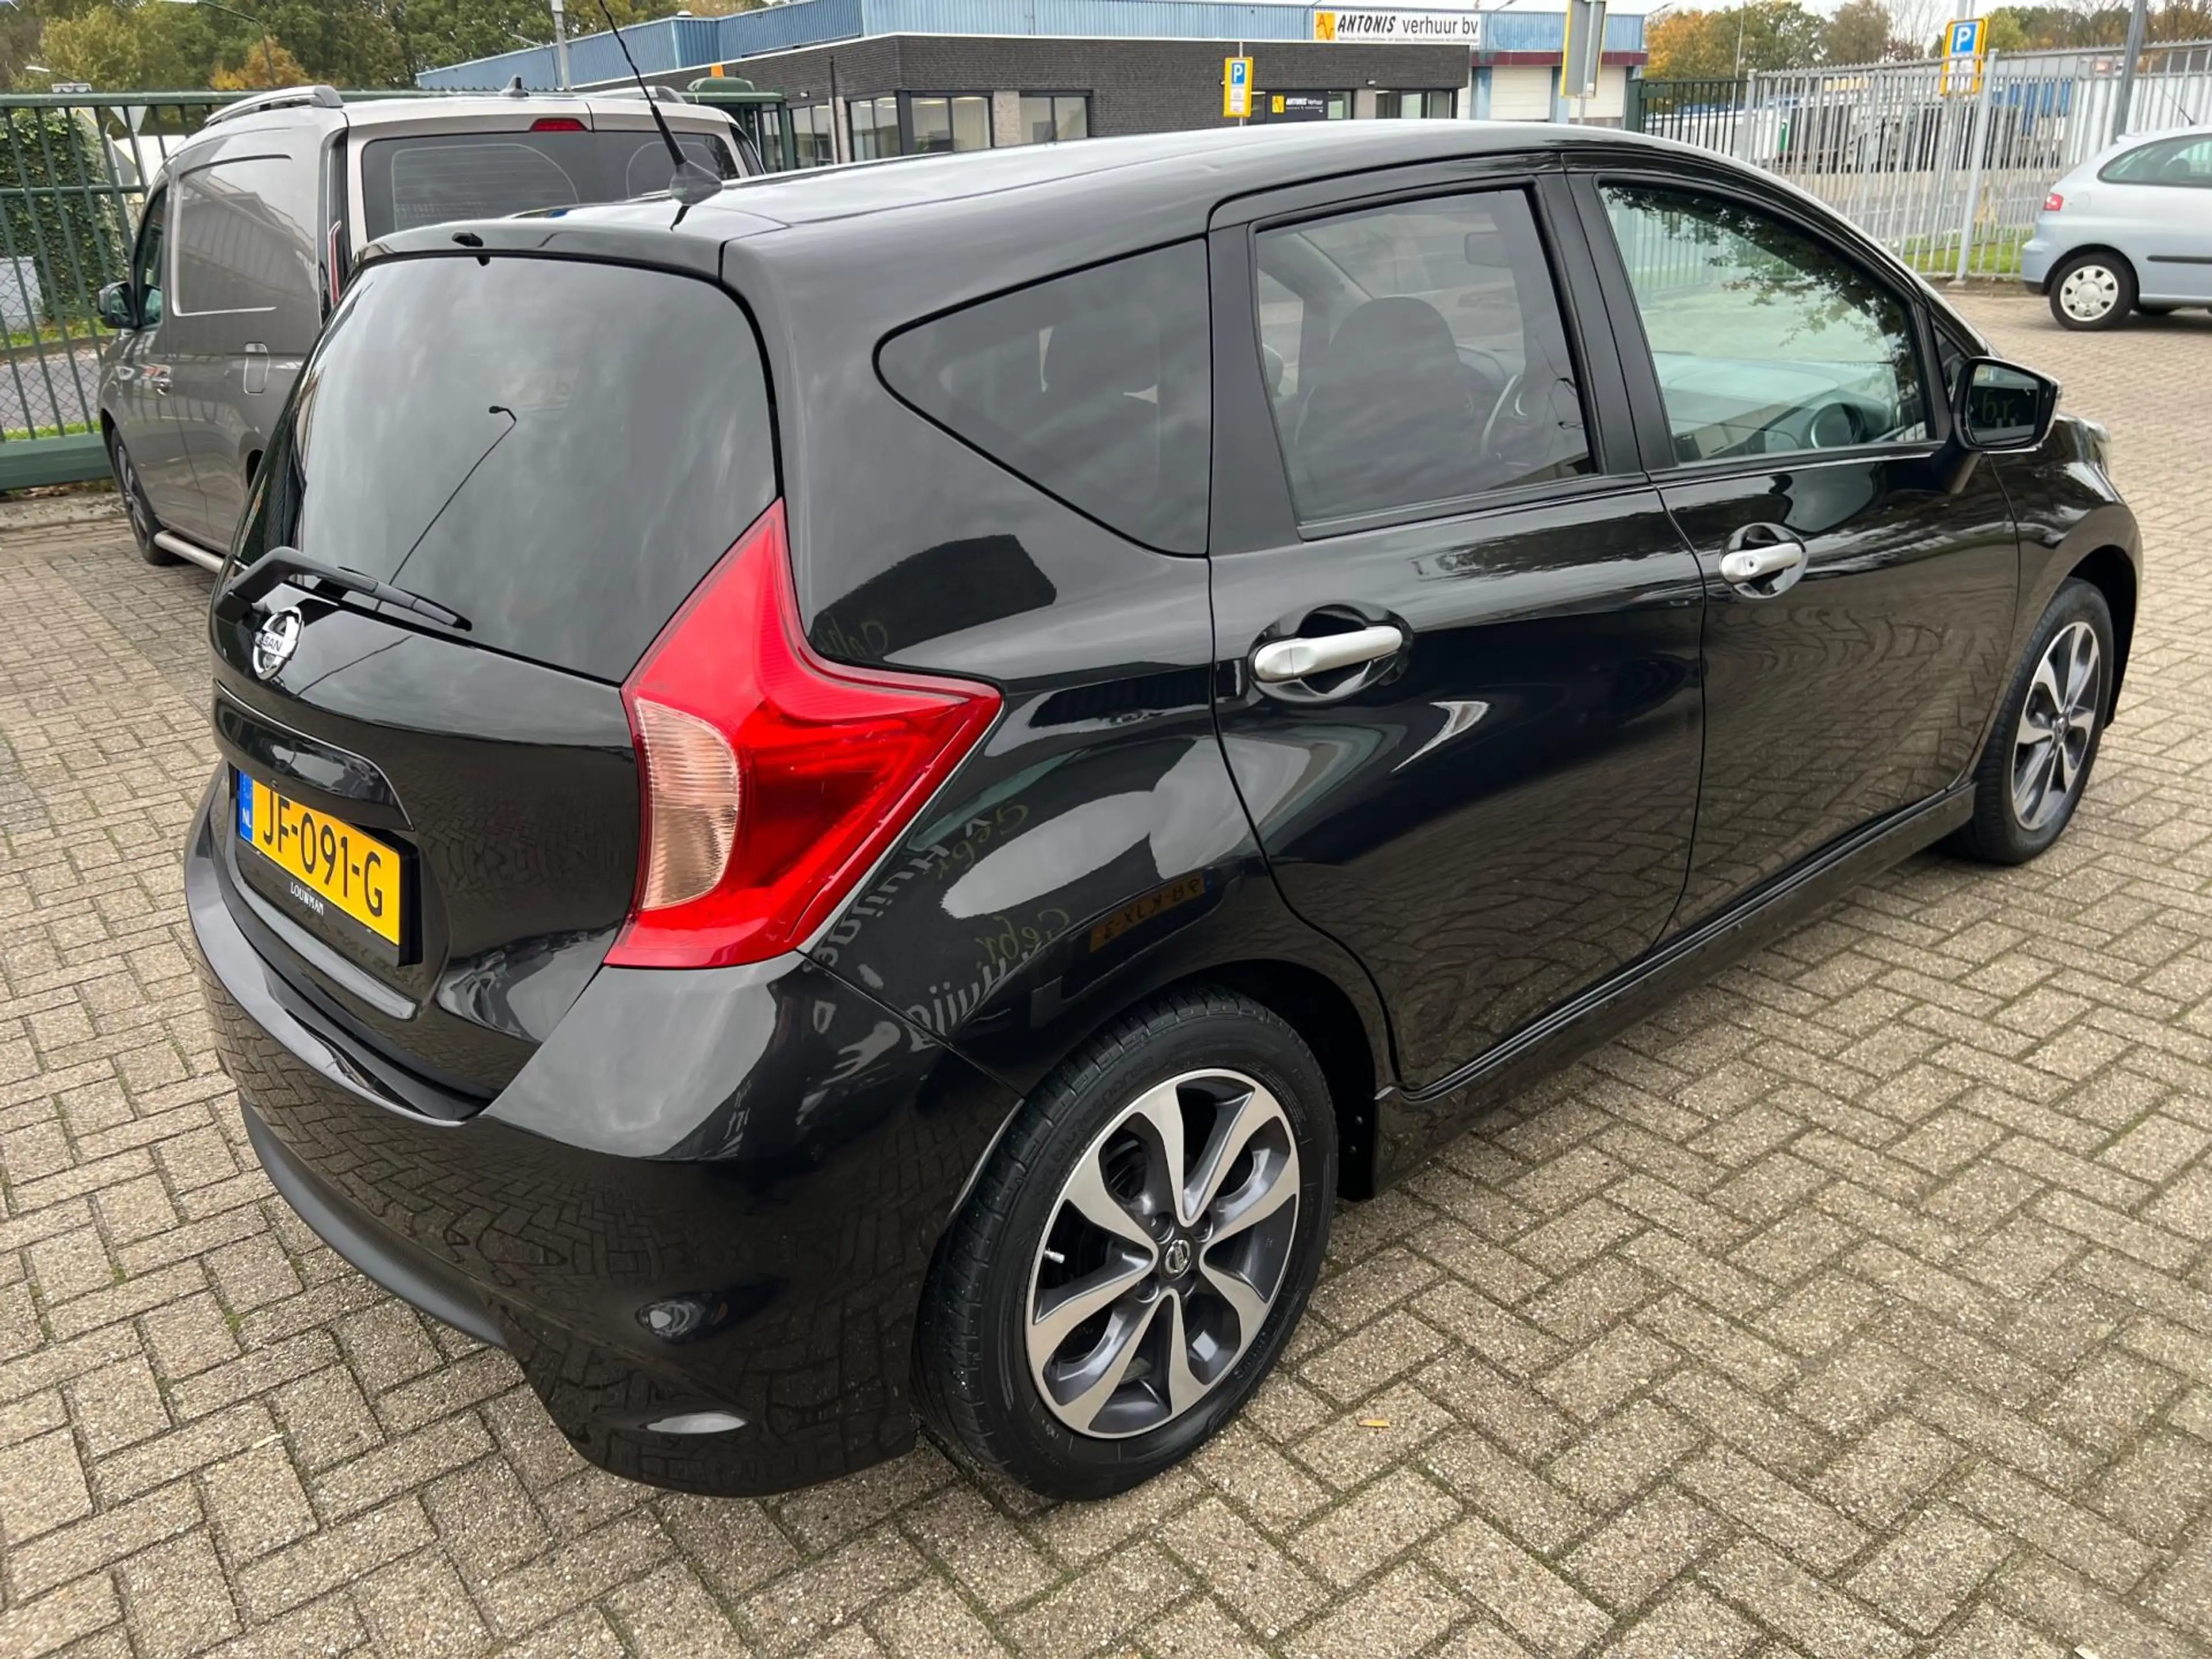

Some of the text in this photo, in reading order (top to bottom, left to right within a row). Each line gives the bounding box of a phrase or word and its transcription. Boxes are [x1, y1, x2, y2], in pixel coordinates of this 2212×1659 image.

[1338, 14, 1479, 35] ANTONIS verhuur bv
[1956, 26, 1971, 50] P
[1233, 64, 1243, 83] P
[242, 807, 252, 828] NL
[263, 790, 382, 918] JF-091-G
[290, 881, 324, 916] LOUWMAN
